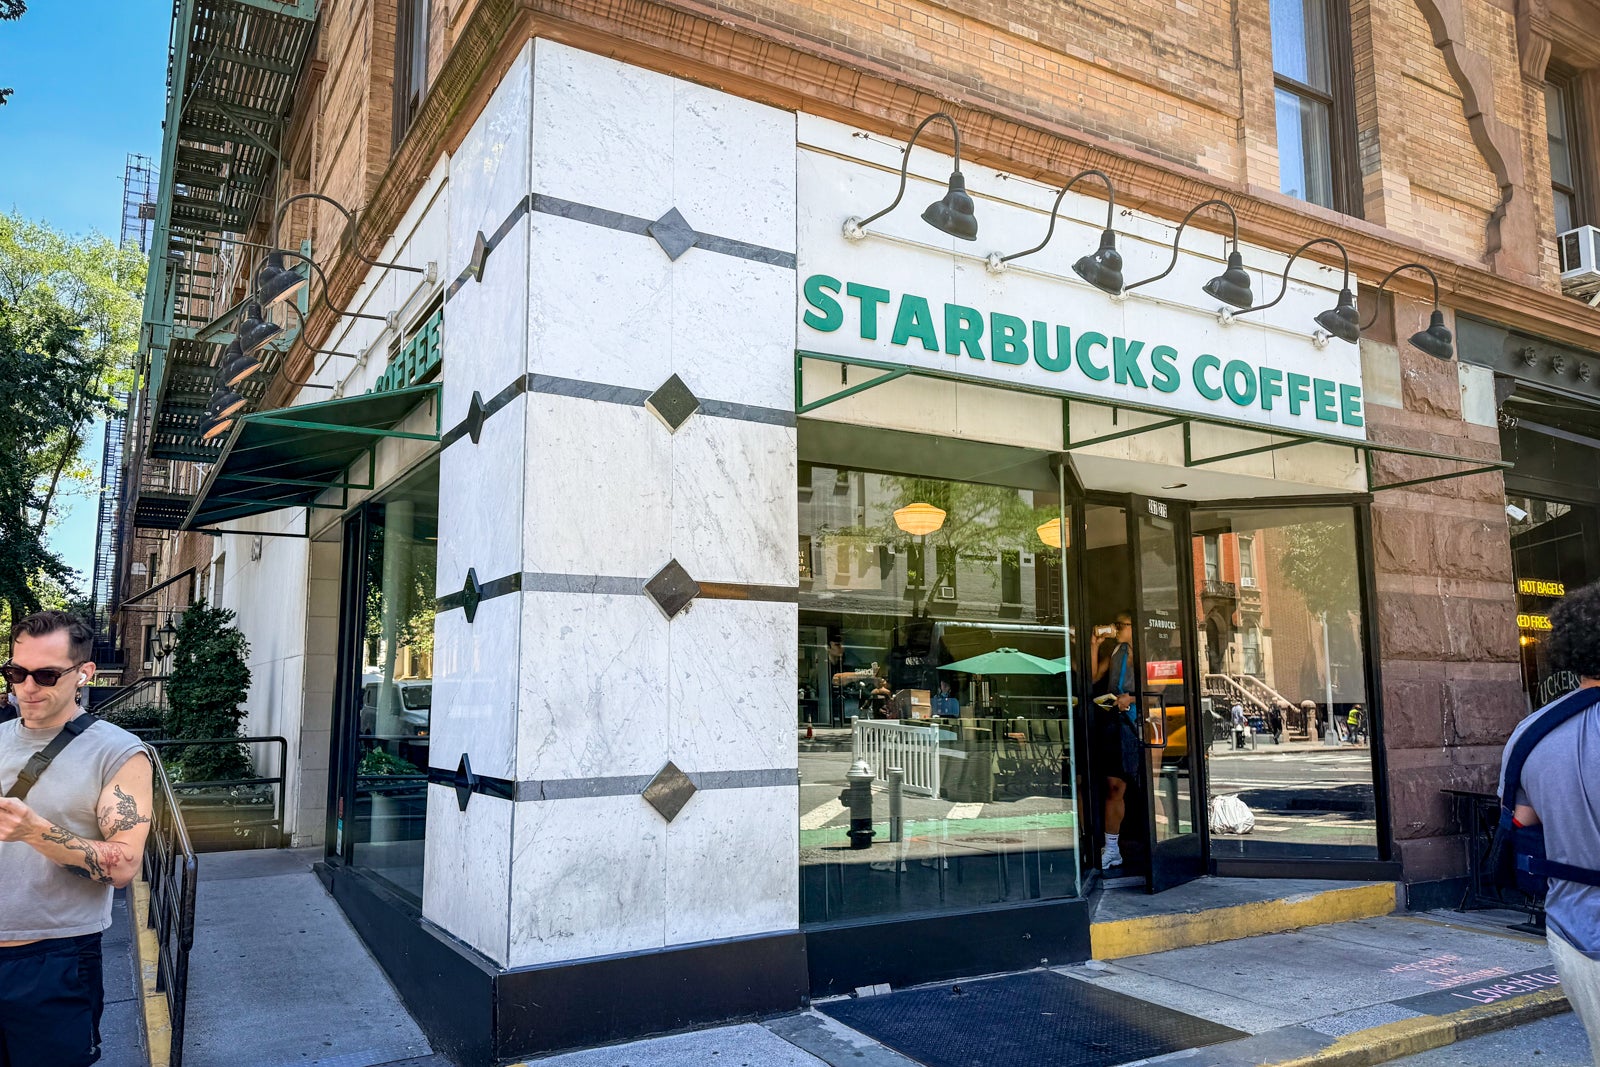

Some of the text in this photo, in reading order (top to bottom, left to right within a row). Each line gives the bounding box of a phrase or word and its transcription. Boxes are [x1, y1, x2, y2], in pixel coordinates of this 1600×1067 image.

[803, 274, 1363, 427] STARBUCKS COFFEE
[1520, 580, 1565, 596] HOT BAGELS
[1149, 619, 1176, 629] STARBUCKS
[1530, 615, 1553, 629] FRES
